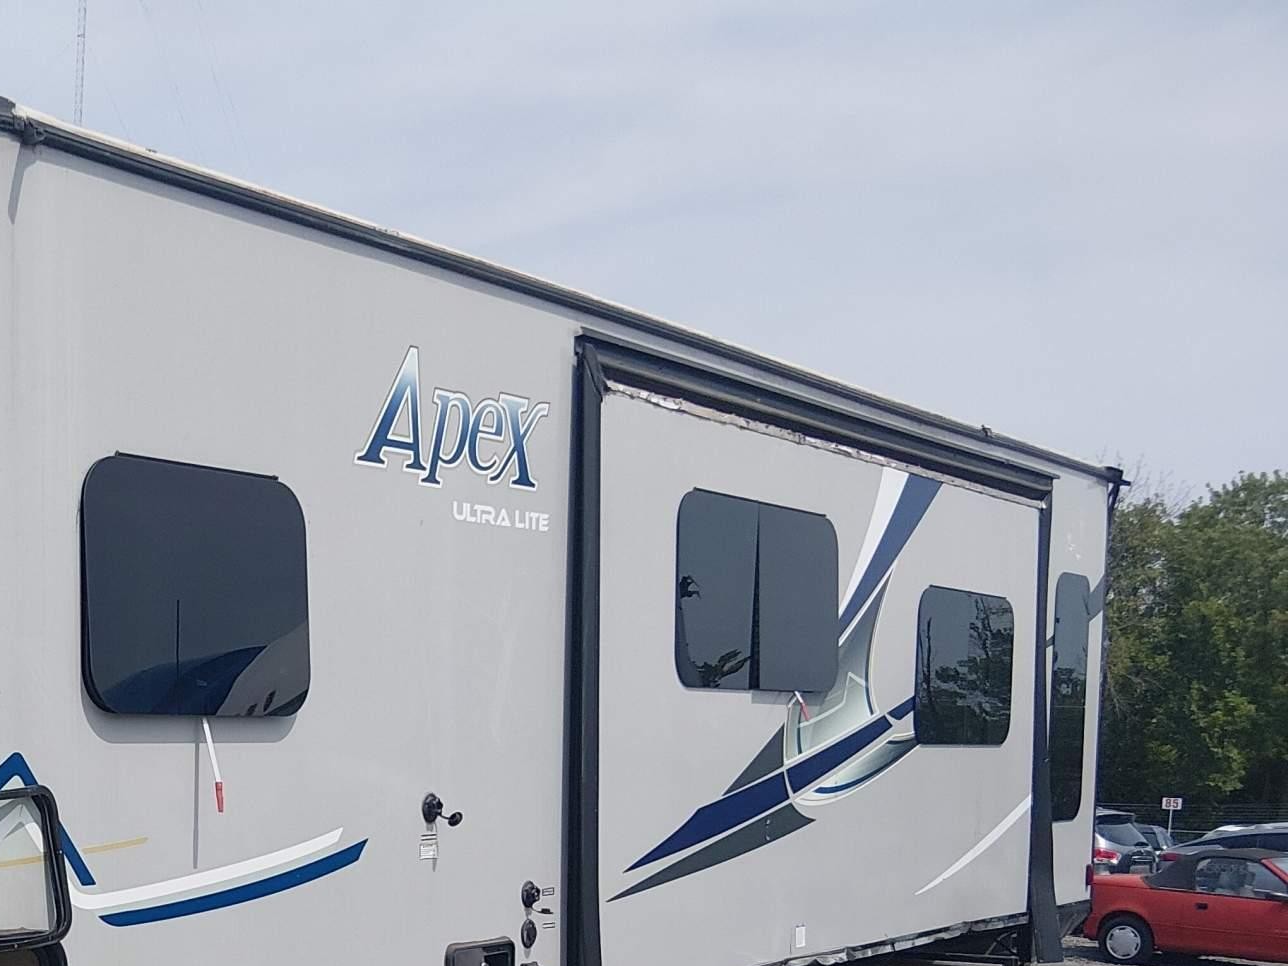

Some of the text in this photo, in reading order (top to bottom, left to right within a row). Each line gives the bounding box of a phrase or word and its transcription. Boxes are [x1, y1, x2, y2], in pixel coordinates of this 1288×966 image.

[354, 345, 551, 492] Apex
[453, 501, 550, 532] ULTRA LITE
